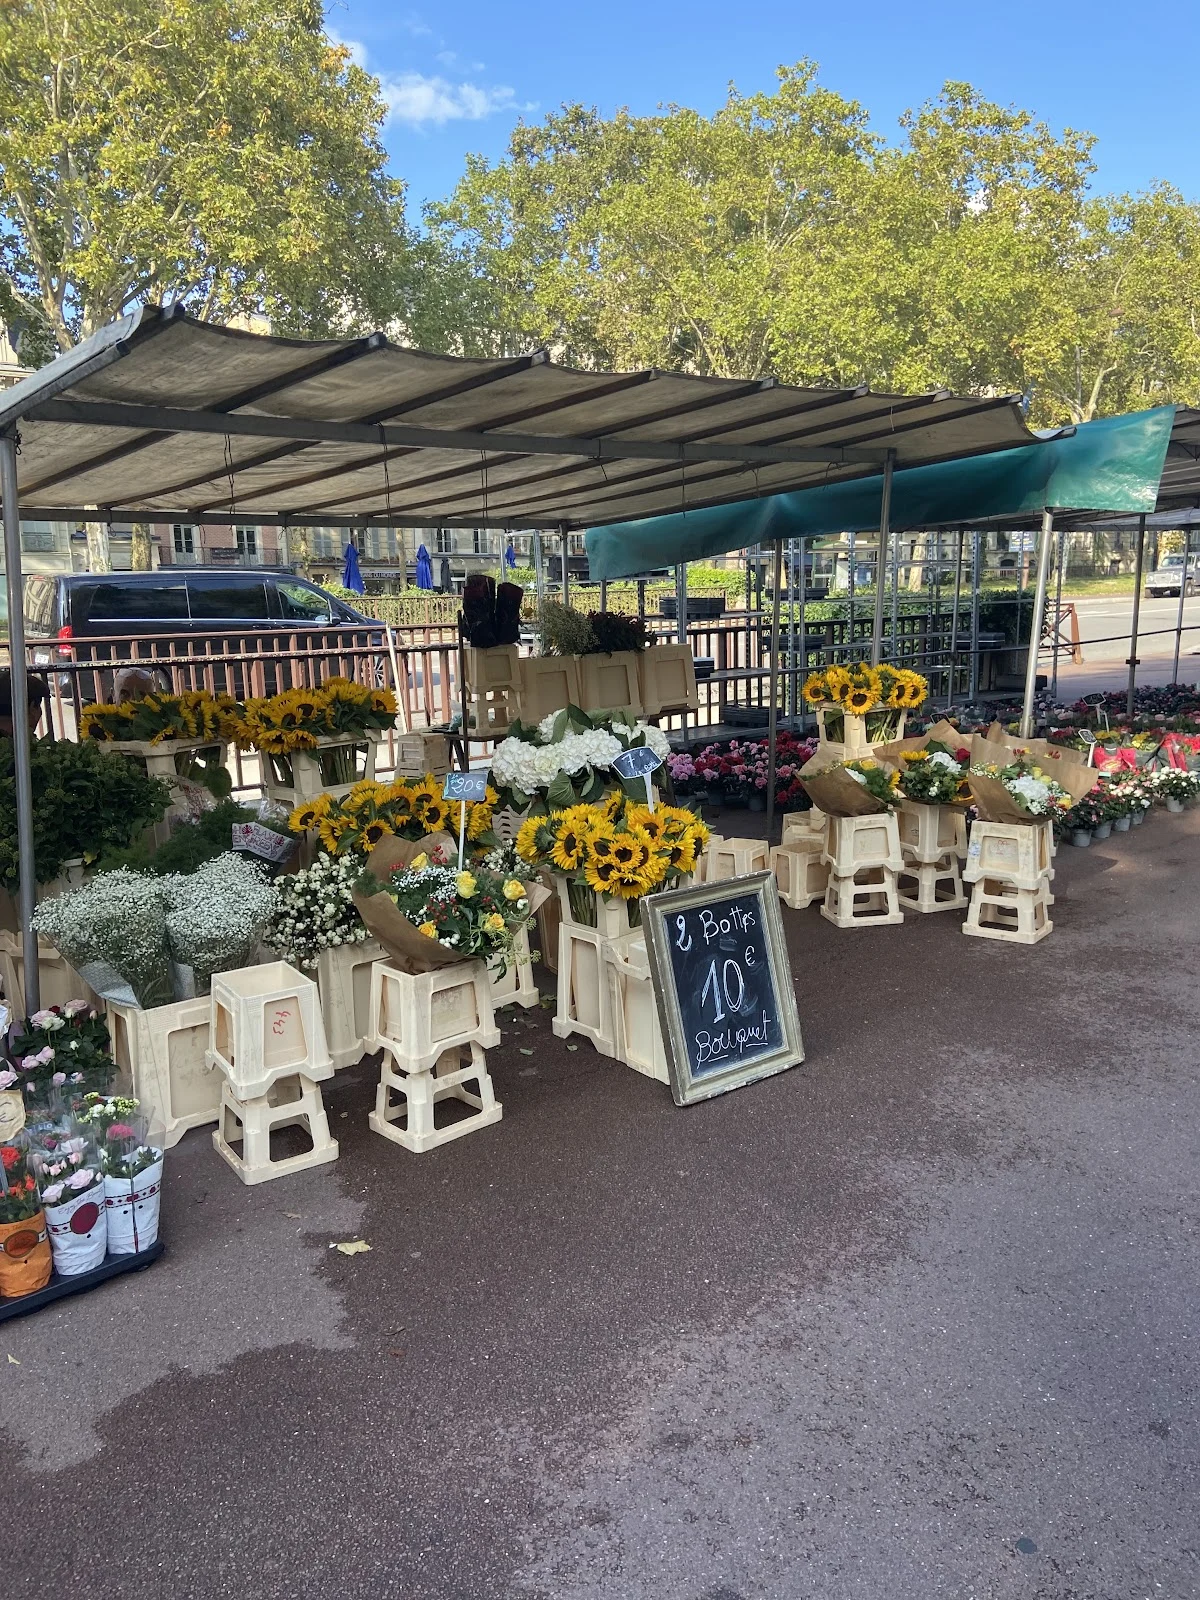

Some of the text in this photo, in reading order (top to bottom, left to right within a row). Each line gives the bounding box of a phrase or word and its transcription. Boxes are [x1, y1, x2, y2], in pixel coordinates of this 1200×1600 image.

[675, 905, 756, 951] 2 Bottes
[695, 1009, 771, 1069] Bouquet
